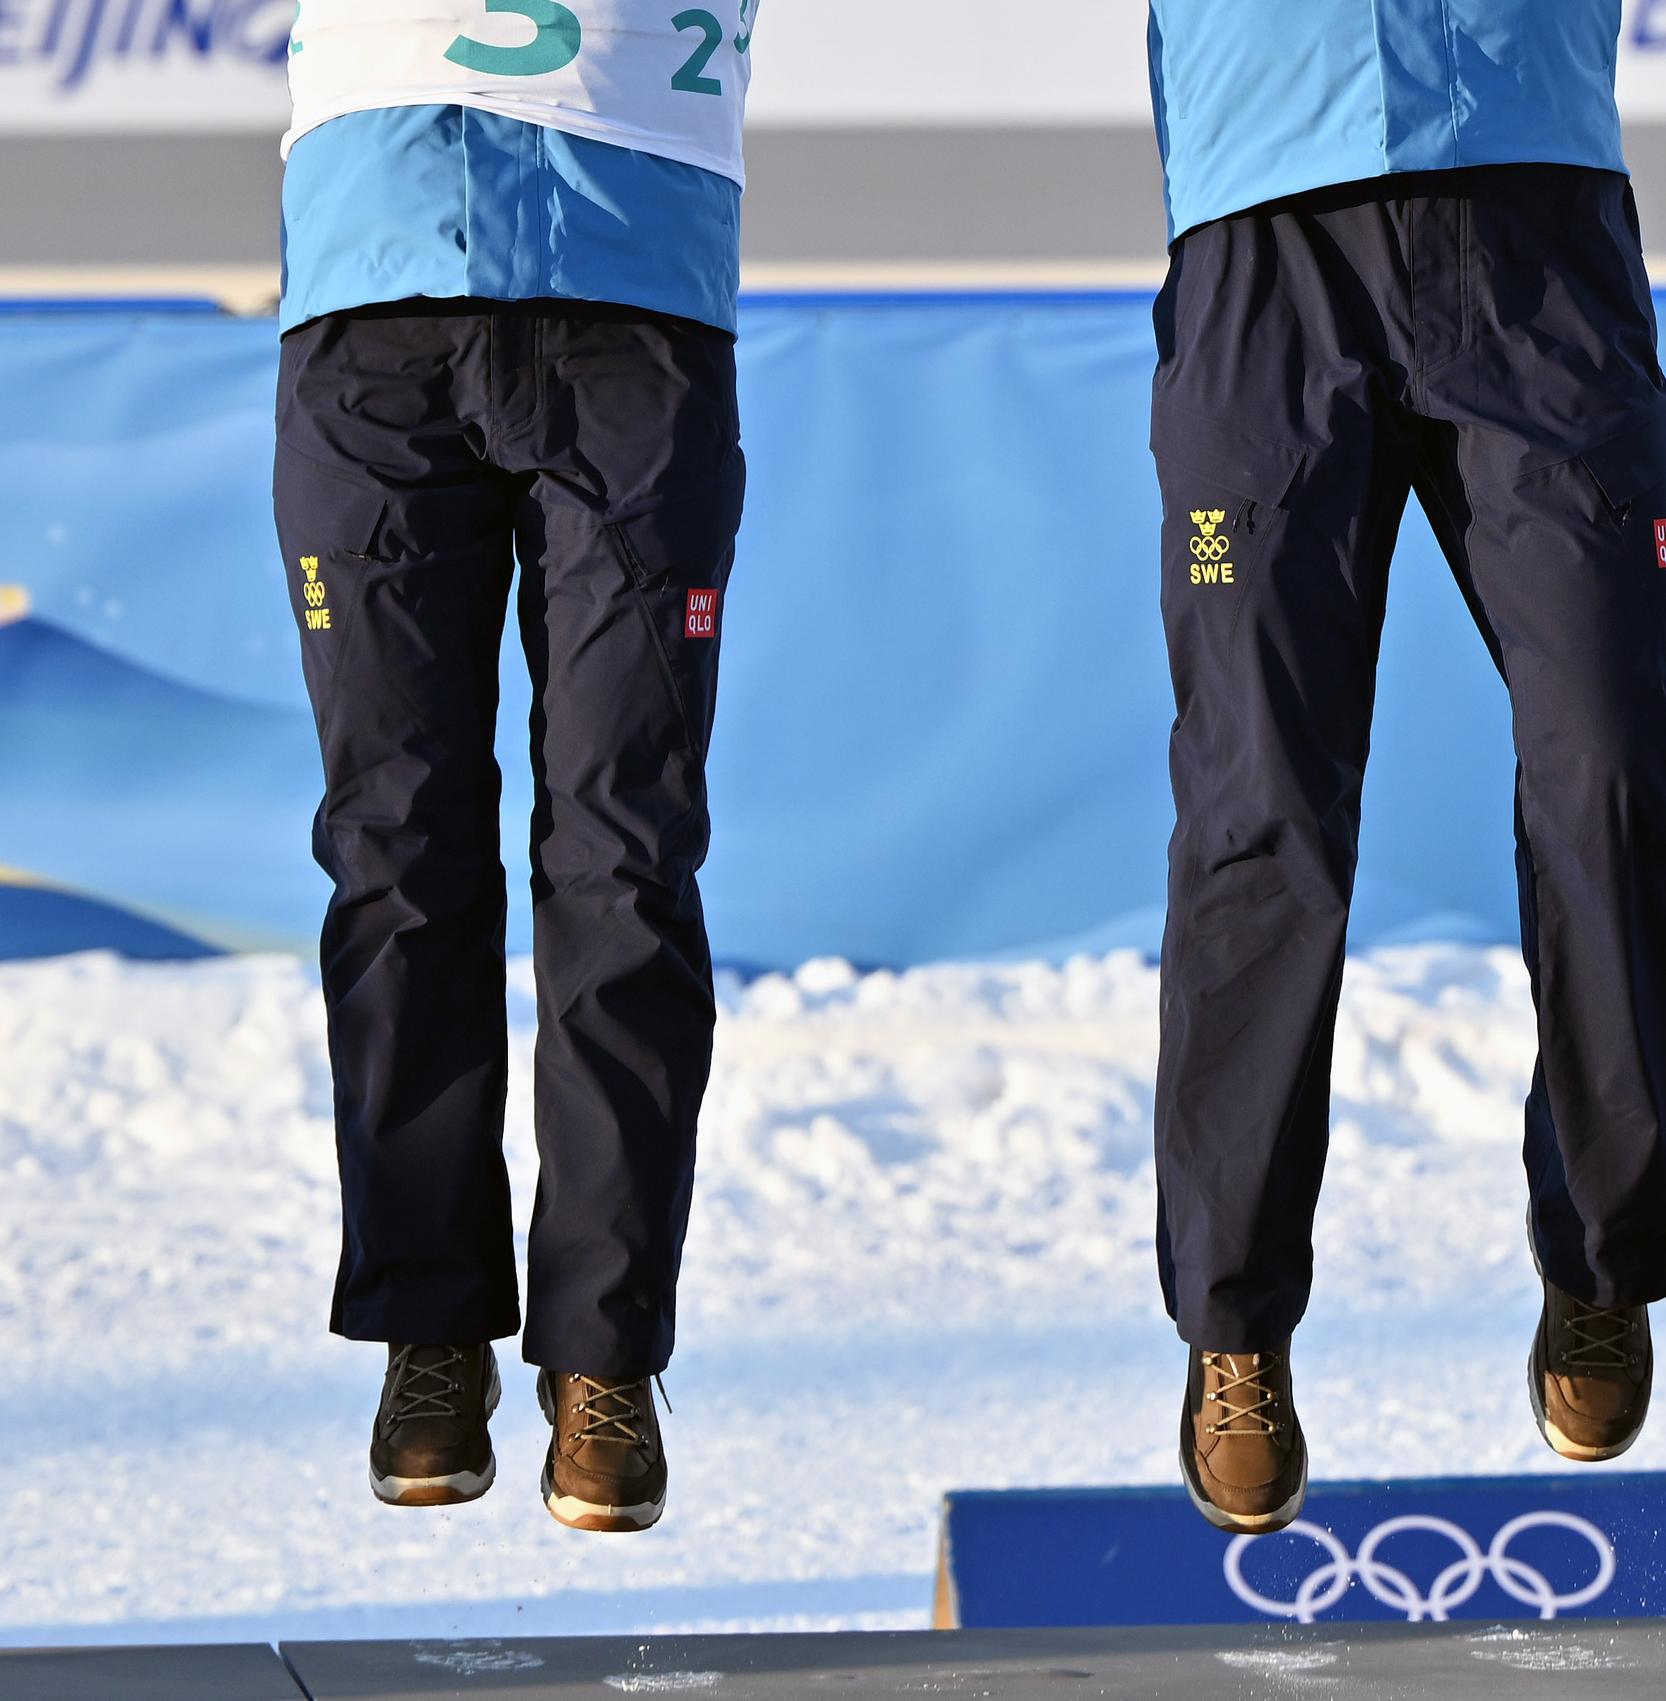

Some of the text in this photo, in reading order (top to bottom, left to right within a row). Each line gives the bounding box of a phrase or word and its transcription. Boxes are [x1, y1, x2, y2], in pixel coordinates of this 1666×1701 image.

[670, 9, 723, 96] 2
[1190, 562, 1235, 585] SWE
[690, 594, 712, 611] UNI
[305, 608, 331, 630] SWE
[688, 614, 712, 635] QLO
